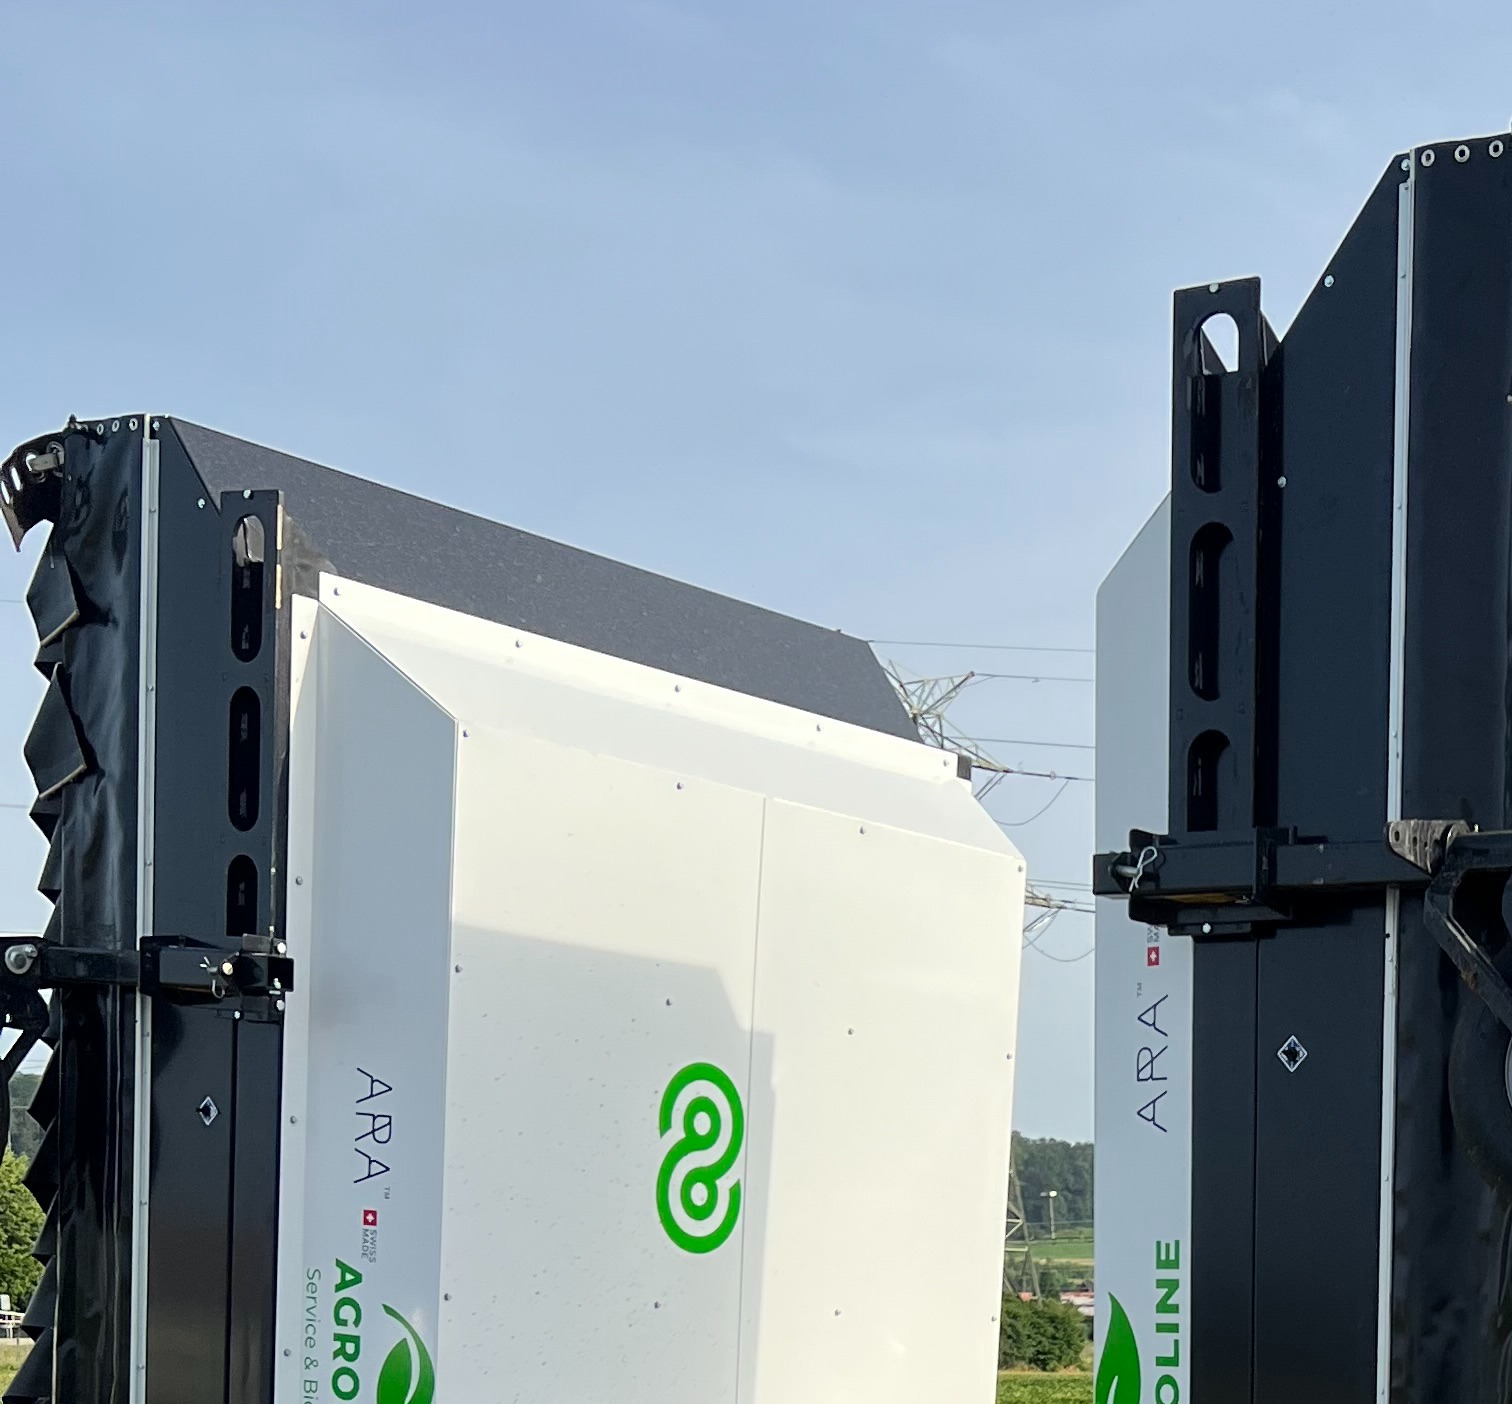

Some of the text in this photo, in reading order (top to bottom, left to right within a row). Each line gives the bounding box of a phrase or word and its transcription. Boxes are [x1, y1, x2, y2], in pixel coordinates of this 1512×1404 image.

[1136, 994, 1169, 1133] ARA
[353, 1067, 393, 1184] ARA
[361, 1228, 370, 1259] MADE
[368, 1229, 378, 1264] SWISS
[303, 1267, 322, 1349] Service
[303, 1356, 319, 1370] &
